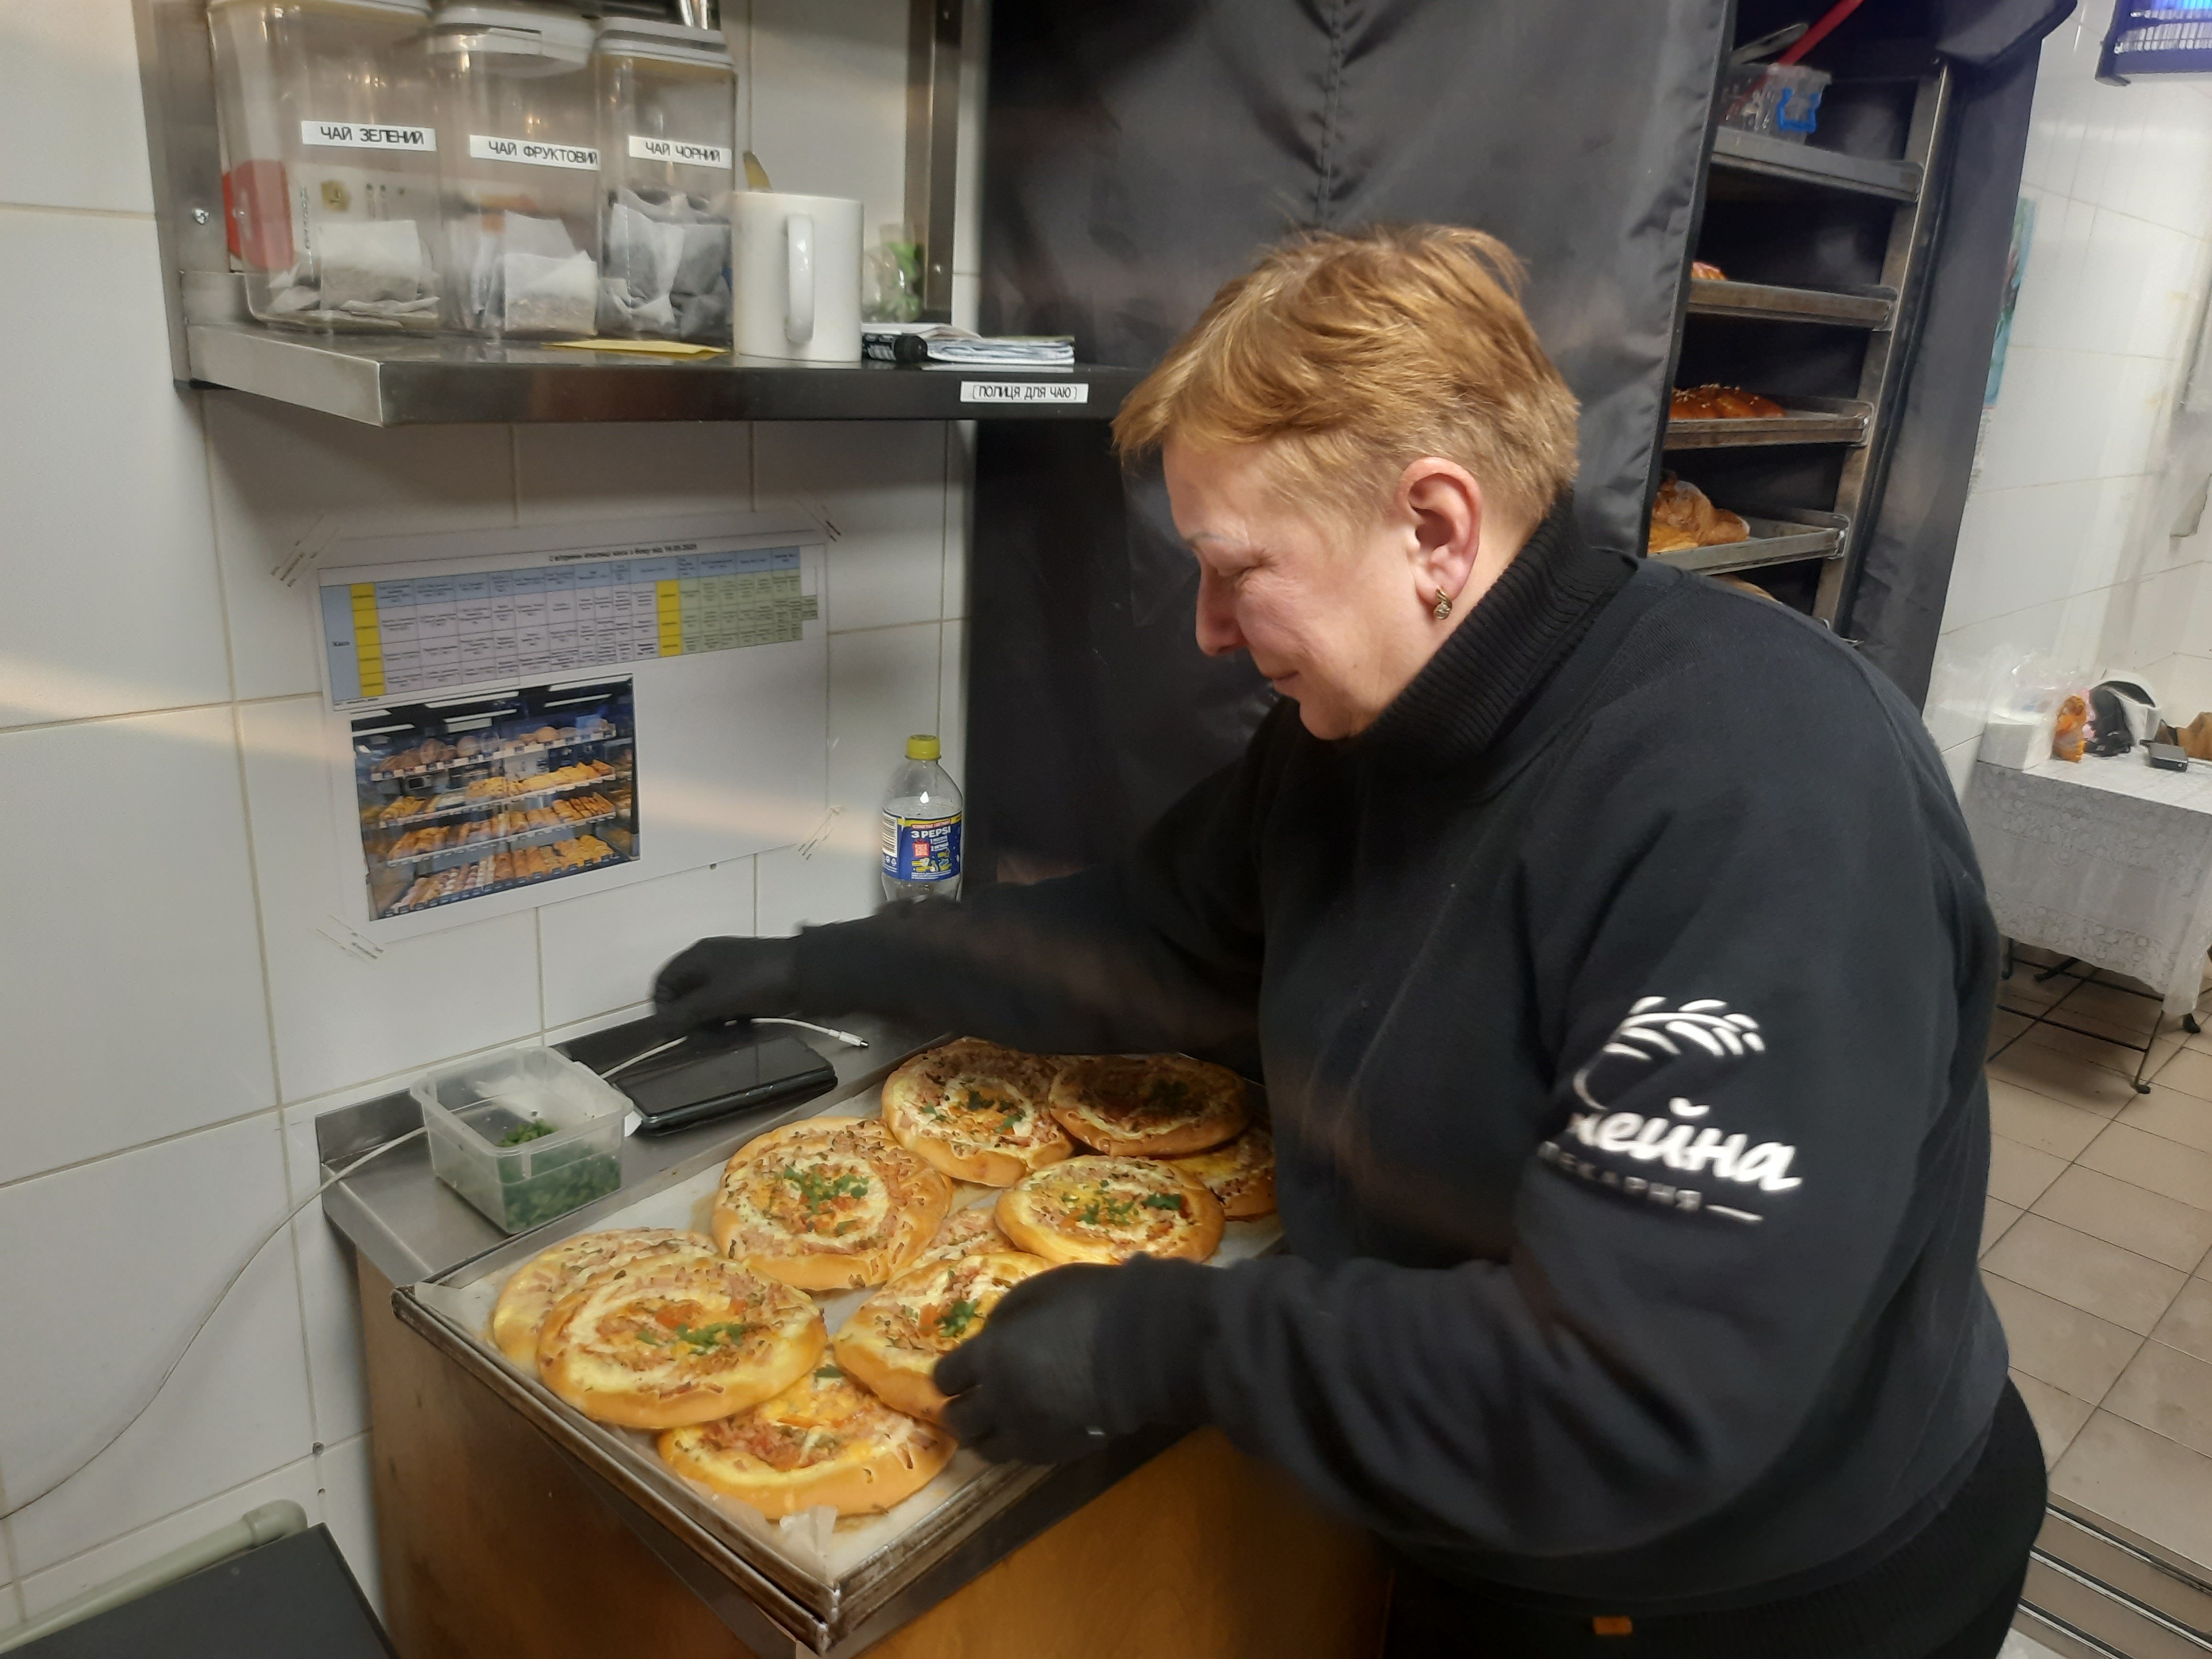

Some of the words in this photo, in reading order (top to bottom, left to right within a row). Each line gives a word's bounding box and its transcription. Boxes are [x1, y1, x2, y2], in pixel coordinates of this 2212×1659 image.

[320, 126, 353, 141] ЧАЙ
[359, 128, 424, 145] ЗЕЛЕНИЙ
[488, 140, 517, 156] ЧАЙ
[523, 145, 598, 165] ФРУКТОВИЙ
[646, 142, 671, 156] ЧАЙ
[675, 145, 720, 162] ЧОРНИЙ
[979, 385, 1020, 400] ПОЛИЦЯ
[1024, 386, 1046, 400] ДЛЯ
[1050, 386, 1072, 398] ЧАЮ
[910, 830, 920, 839] 3
[921, 826, 951, 838] PEPSI
